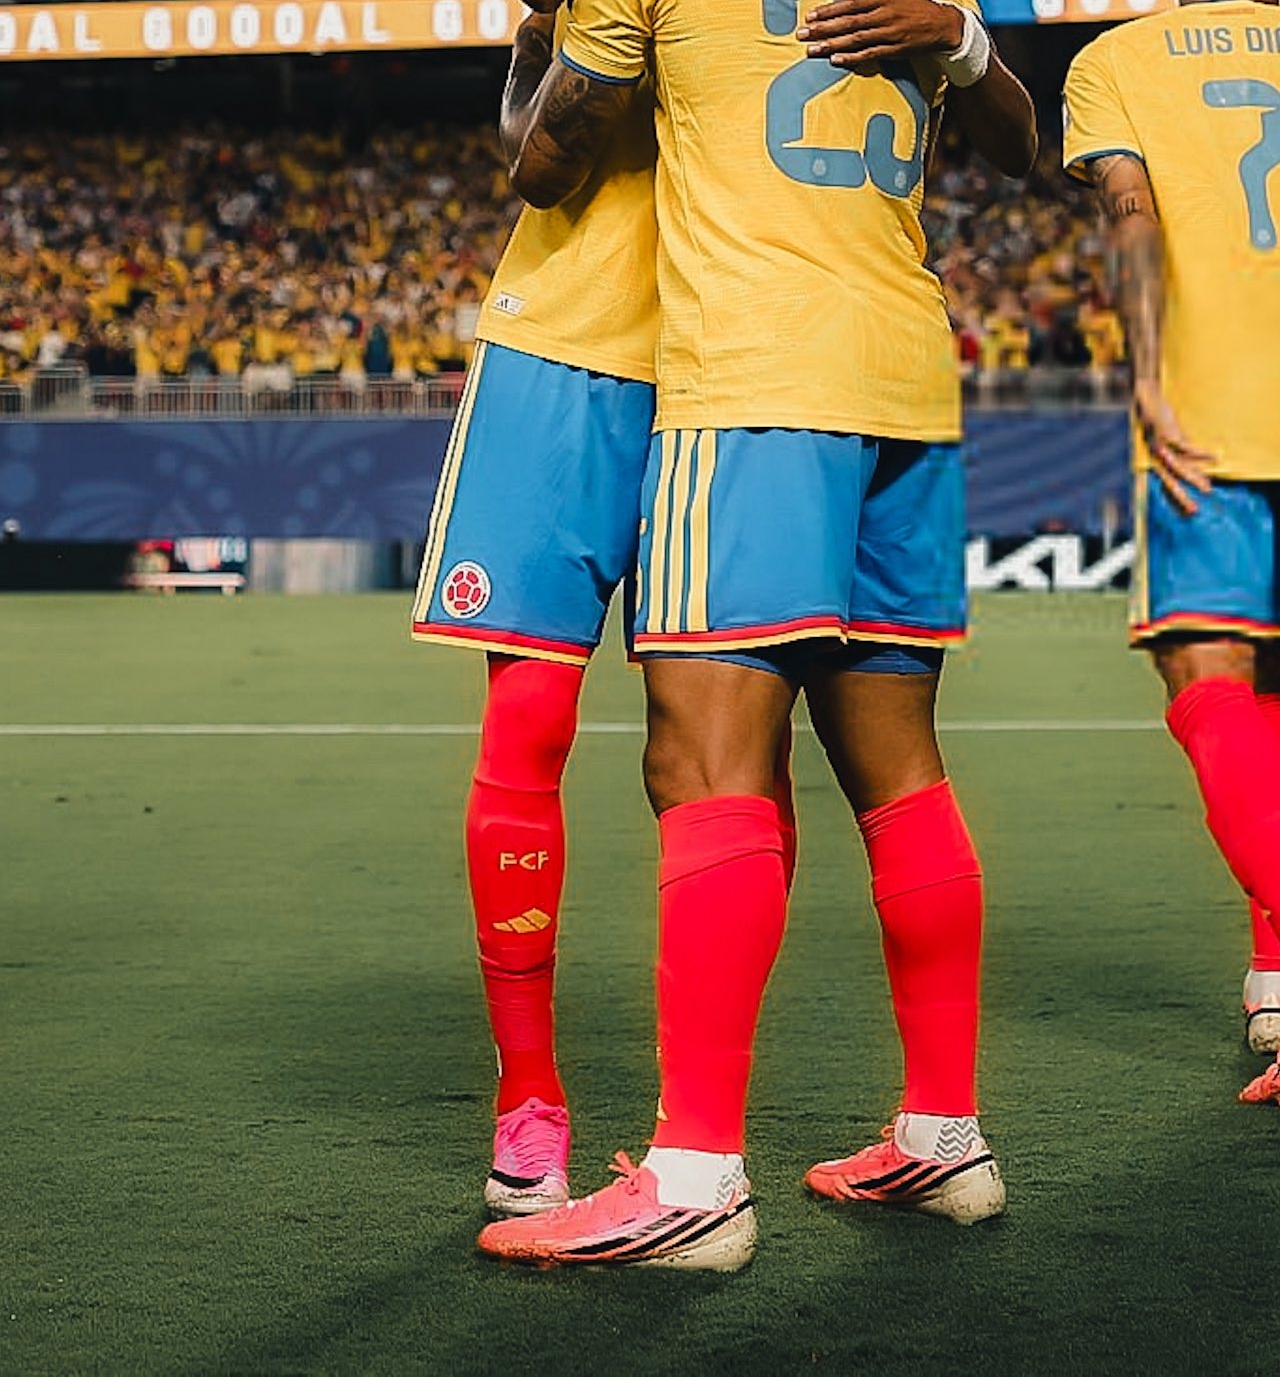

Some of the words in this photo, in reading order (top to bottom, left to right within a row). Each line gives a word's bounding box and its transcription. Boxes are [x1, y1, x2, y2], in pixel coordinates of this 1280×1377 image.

[142, 0, 391, 51] GOOOAL
[1165, 27, 1233, 56] LUIS
[500, 850, 550, 871] FCF
